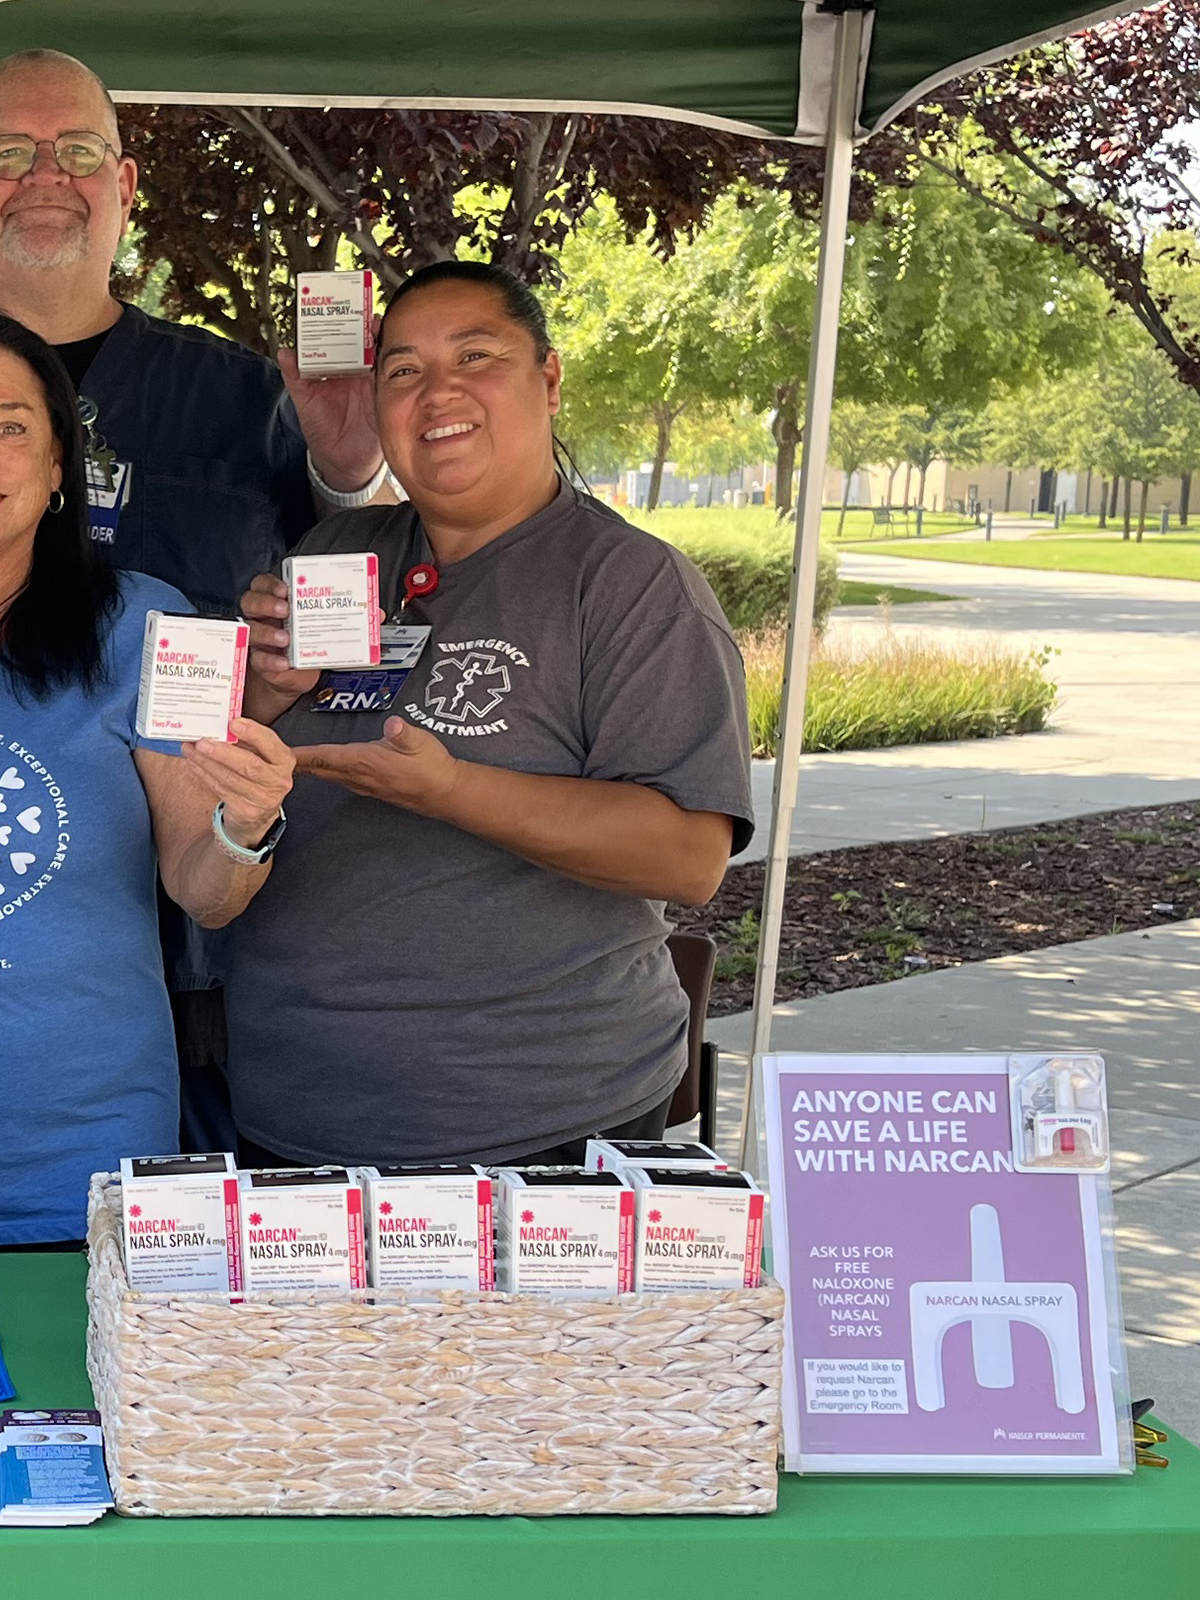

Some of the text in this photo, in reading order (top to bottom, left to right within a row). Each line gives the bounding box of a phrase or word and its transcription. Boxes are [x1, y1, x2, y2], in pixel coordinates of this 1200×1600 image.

[301, 306, 351, 317] NASAL SPRAY
[296, 597, 352, 610] NASAL SPRAY
[438, 638, 530, 668] EMERGENCY
[156, 665, 217, 680] NASAL SPRAY
[330, 692, 377, 710] RN
[404, 703, 509, 737] DEPARTMENT
[8, 742, 70, 828] EXCEPTIONAL
[792, 1090, 997, 1113] ANYONE CAN
[794, 1120, 968, 1143] SAVE A LIFE
[794, 1150, 1014, 1173] WITH NARCAN
[130, 1232, 226, 1249] NASAL SPRAY 4 mg
[380, 1233, 478, 1249] NASAL SPRAY 4 mg
[250, 1243, 349, 1259] NASAL SPRAY 4 mg
[520, 1243, 558, 1258] NASAL
[560, 1243, 598, 1258] SPRAY
[604, 1251, 618, 1259] mg
[645, 1242, 744, 1262] NASAL SPRAY 4 mg
[810, 1246, 894, 1258] ASK US FOR
[835, 1262, 870, 1274] FREE
[812, 1278, 894, 1290] NALOXONE
[818, 1294, 890, 1307] (NARCAN)
[926, 1295, 1063, 1307] NARCAN NASAL SPRAY
[832, 1309, 879, 1321] NASAL
[830, 1325, 882, 1337] SPRAYS
[808, 1362, 902, 1372] If you would like to
[816, 1375, 895, 1386] request Narcan
[816, 1388, 898, 1399] please go to the
[810, 1400, 905, 1412] Emergency Room.
[1008, 1432, 1086, 1440] KAISER PERMANENTE
